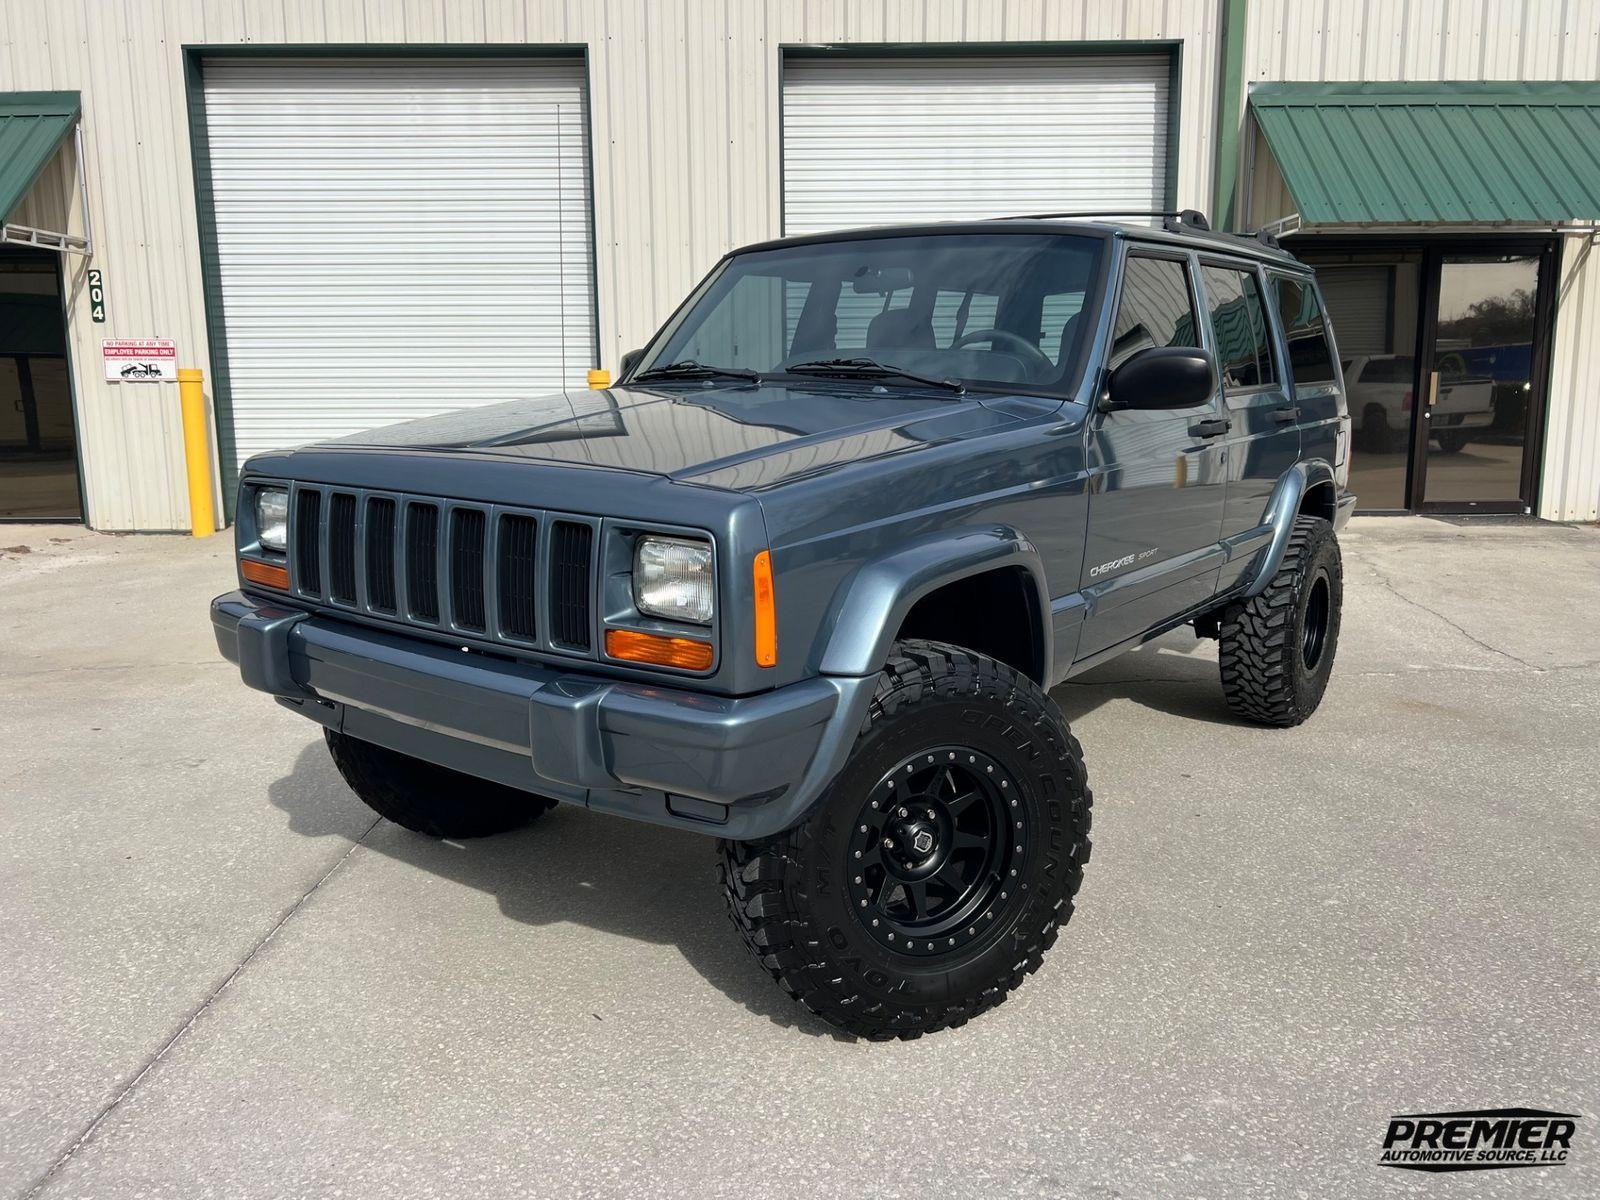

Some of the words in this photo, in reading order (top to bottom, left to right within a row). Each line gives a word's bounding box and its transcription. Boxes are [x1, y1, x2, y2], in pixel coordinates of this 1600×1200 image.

[89, 271, 104, 320] 204
[1090, 554, 1135, 577] CHEROKEE
[1138, 547, 1159, 560] SPORT
